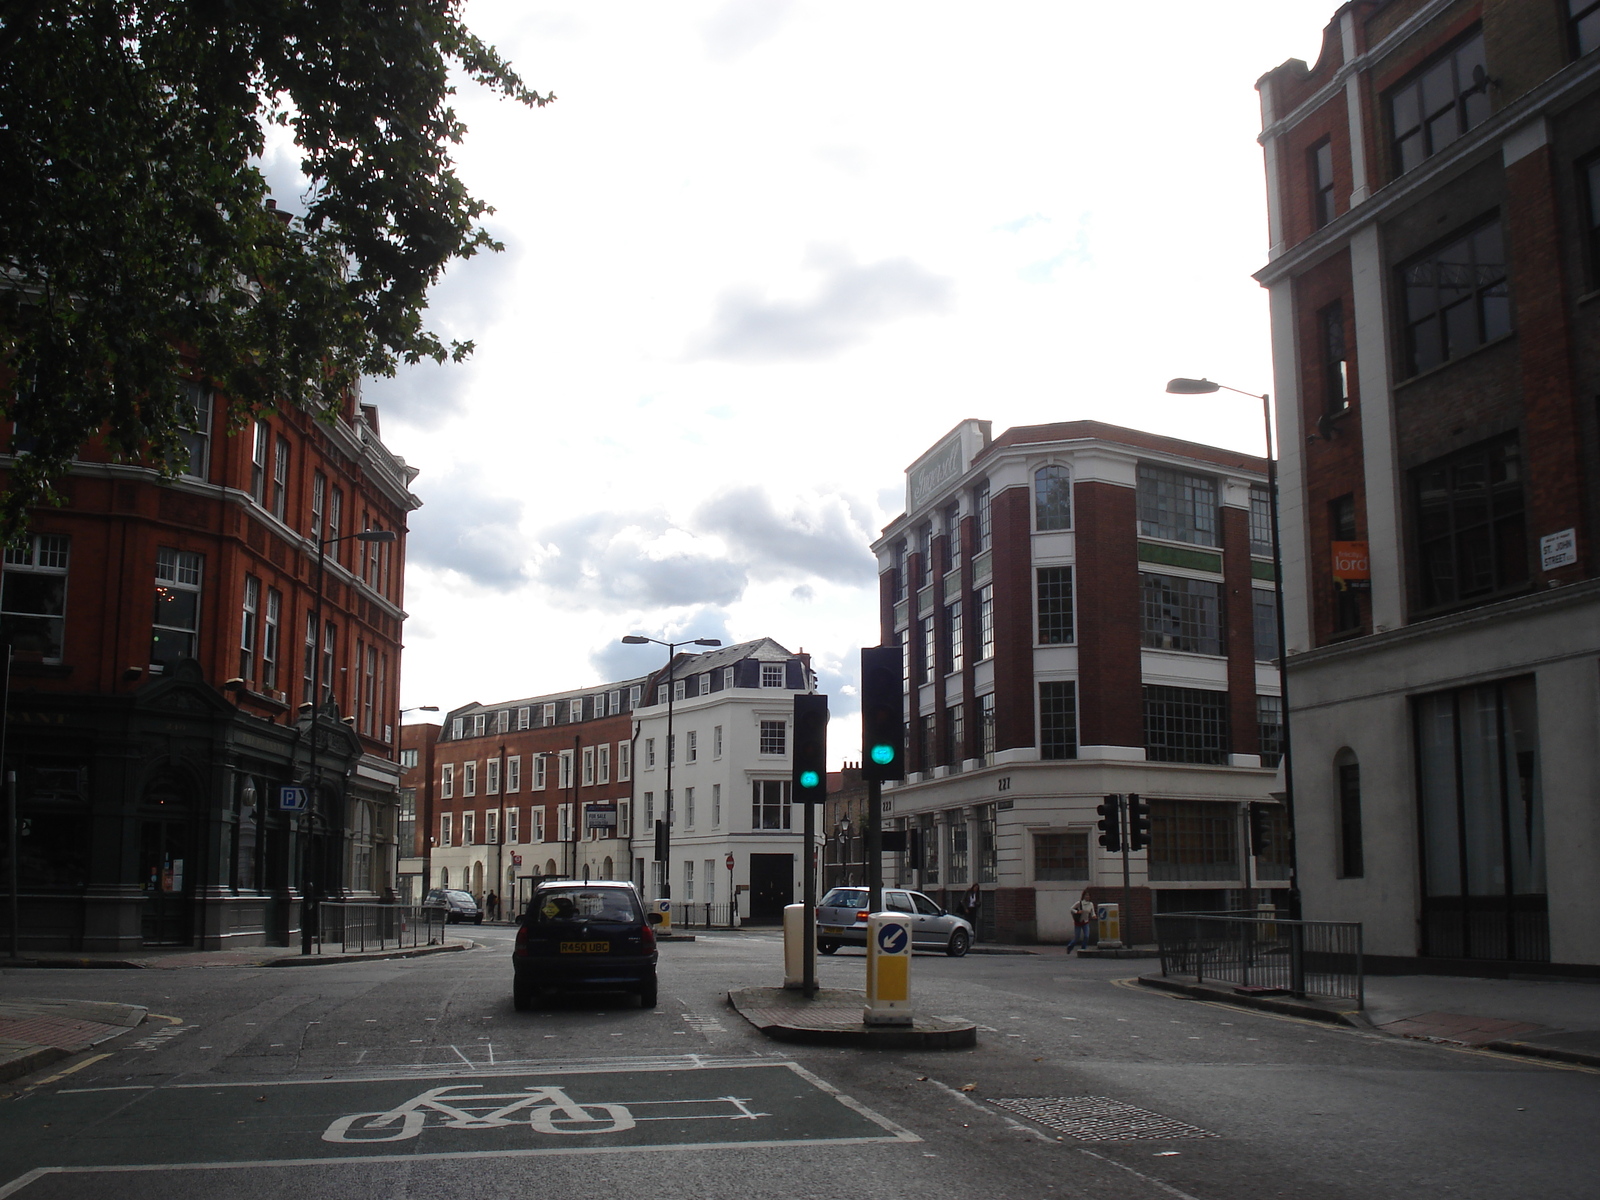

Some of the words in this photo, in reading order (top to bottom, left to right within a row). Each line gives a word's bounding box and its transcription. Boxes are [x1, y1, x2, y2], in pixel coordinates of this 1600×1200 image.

[1556, 540, 1572, 551] JOHN
[1335, 556, 1368, 571] lord
[1544, 553, 1566, 566] STREET
[998, 777, 1011, 792] 227
[286, 791, 294, 805] P
[589, 942, 609, 952] UBC
